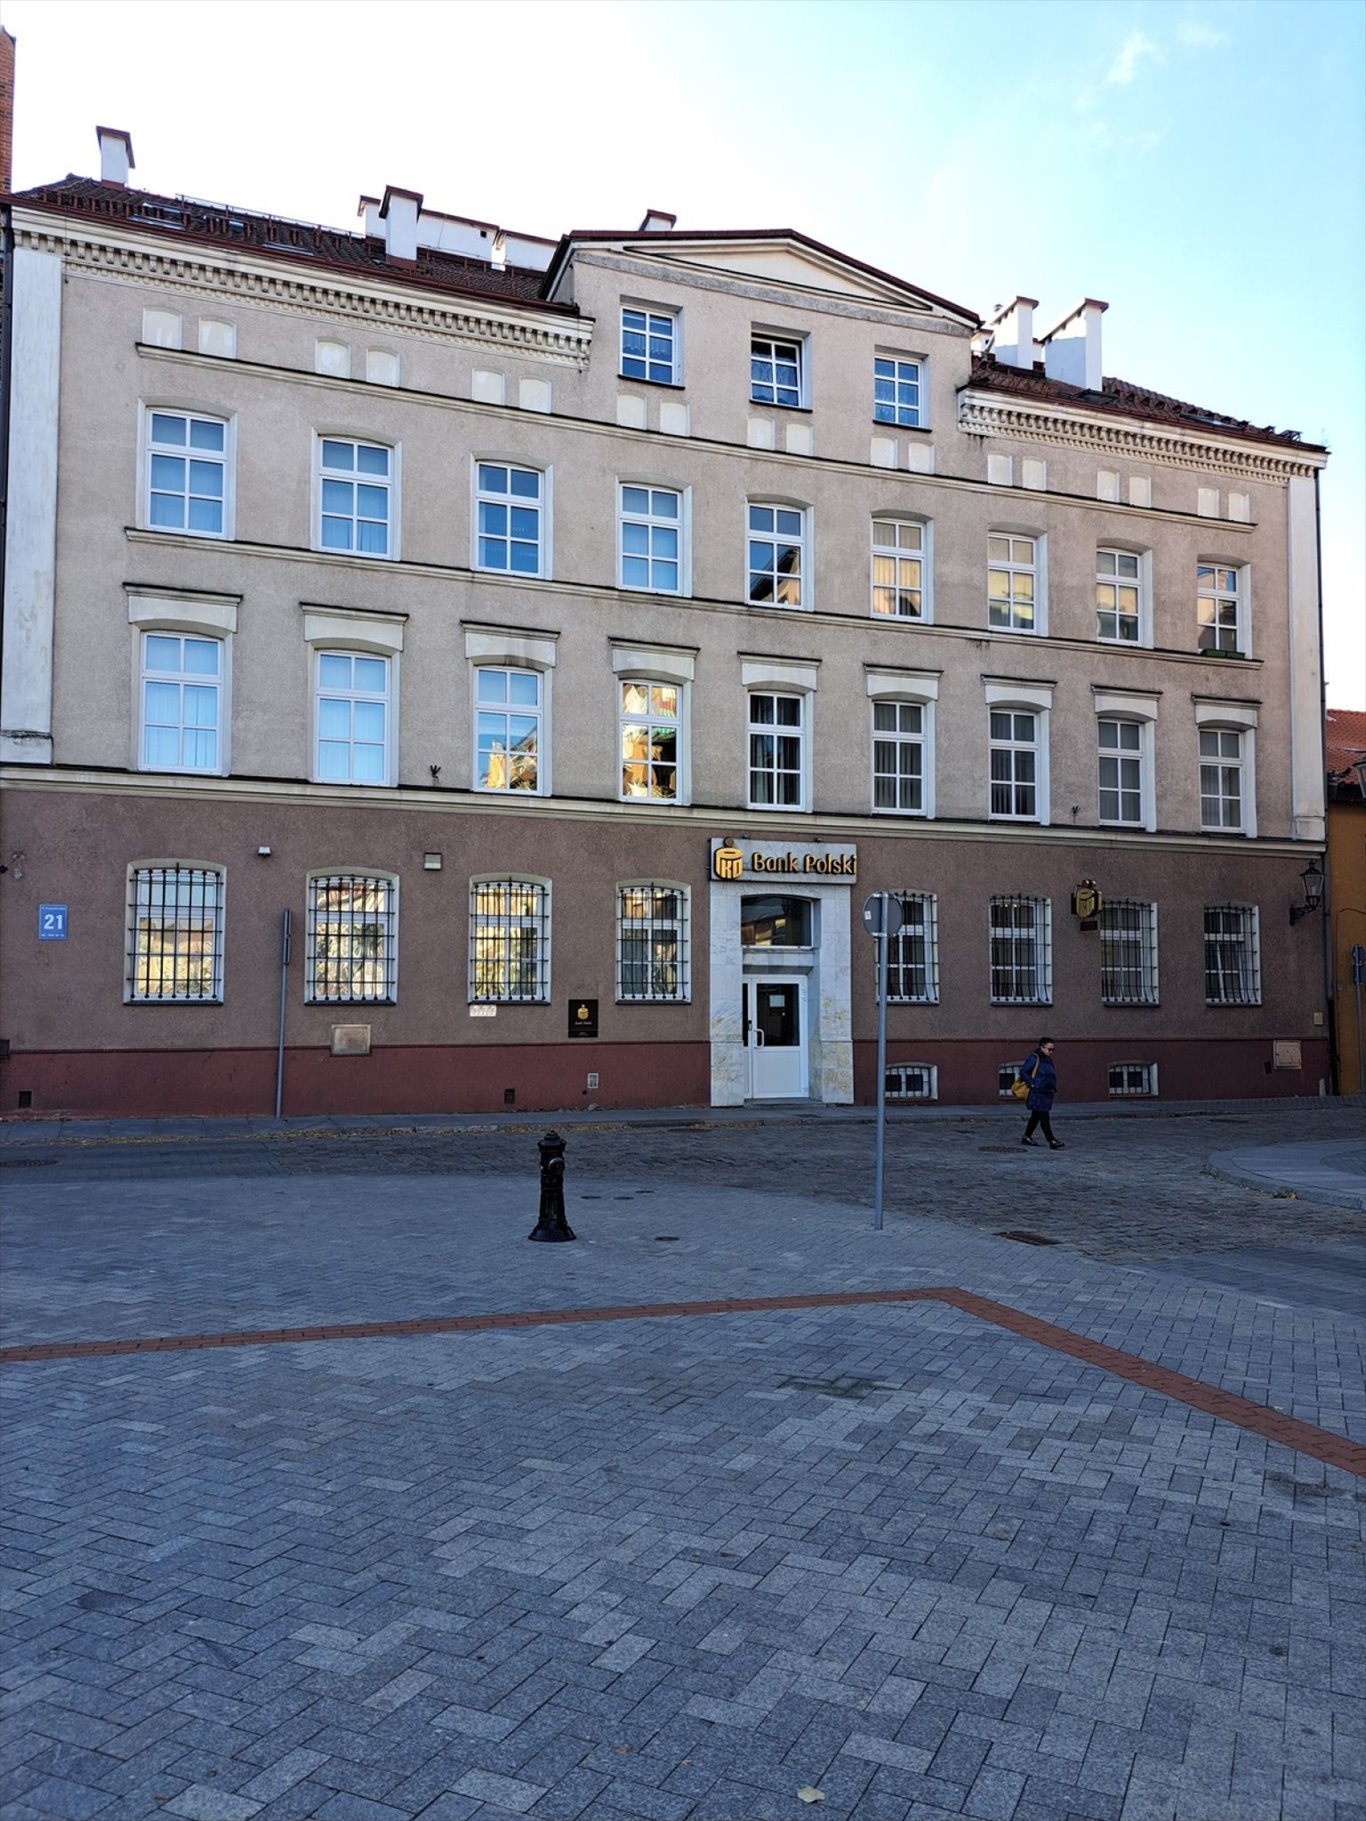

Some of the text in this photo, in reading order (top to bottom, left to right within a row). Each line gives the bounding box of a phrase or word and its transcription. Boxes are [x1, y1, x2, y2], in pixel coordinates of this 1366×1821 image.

[752, 852, 798, 873] Bank
[804, 853, 858, 874] Polski
[44, 914, 63, 930] 21
